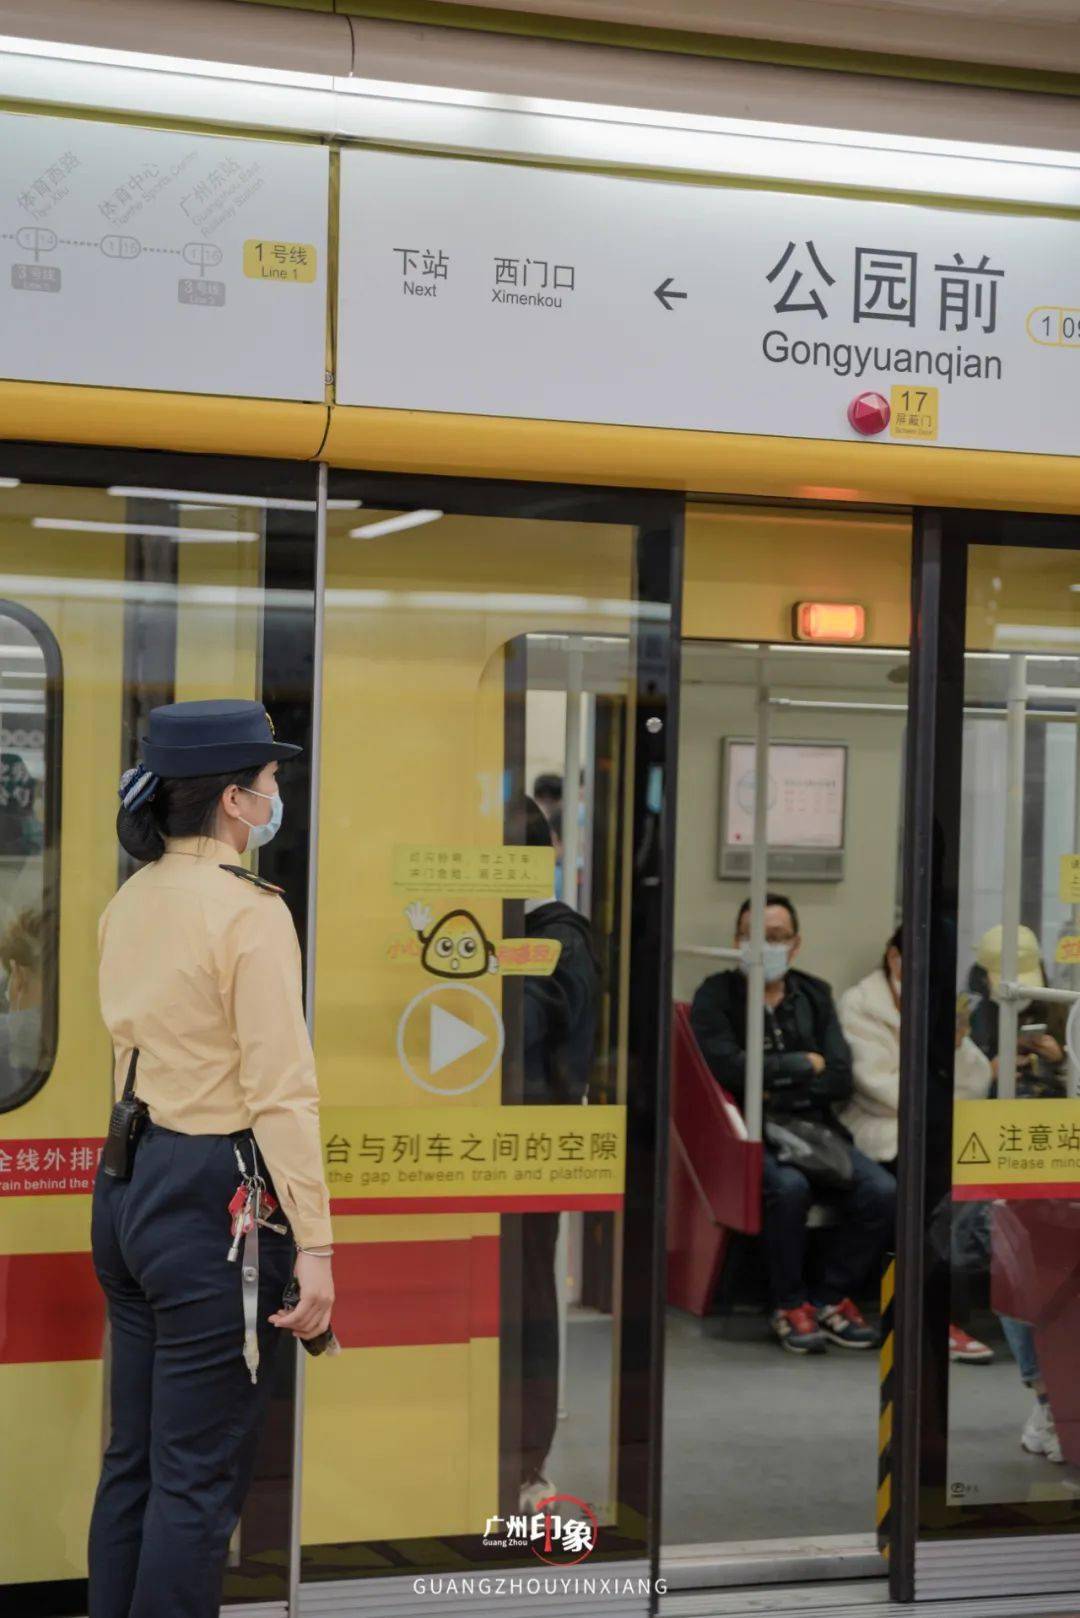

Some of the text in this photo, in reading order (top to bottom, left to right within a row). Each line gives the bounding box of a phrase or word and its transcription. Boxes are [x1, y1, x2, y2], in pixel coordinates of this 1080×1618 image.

[98, 163, 160, 220] 体育中心
[179, 155, 241, 217] 广州东站
[262, 266, 299, 280] Line 1
[393, 248, 575, 291] 下站 西门口
[403, 281, 562, 308] Next Ximenkou
[765, 240, 1005, 334] 公园前
[1042, 315, 1080, 339] 1 0
[762, 330, 1002, 384] Gongyuanqian
[902, 390, 928, 412] 17
[325, 1132, 618, 1164] 台与列车之间的空隙
[998, 1123, 1080, 1151] 注意站
[0, 1147, 103, 1172] 全线外排
[998, 1156, 1044, 1170] Please
[24, 1178, 66, 1190] behind
[70, 1178, 88, 1188] the
[328, 1169, 353, 1183] the
[361, 1171, 390, 1187] gap
[399, 1168, 464, 1183] between
[472, 1167, 508, 1181] train
[514, 1166, 542, 1180] and
